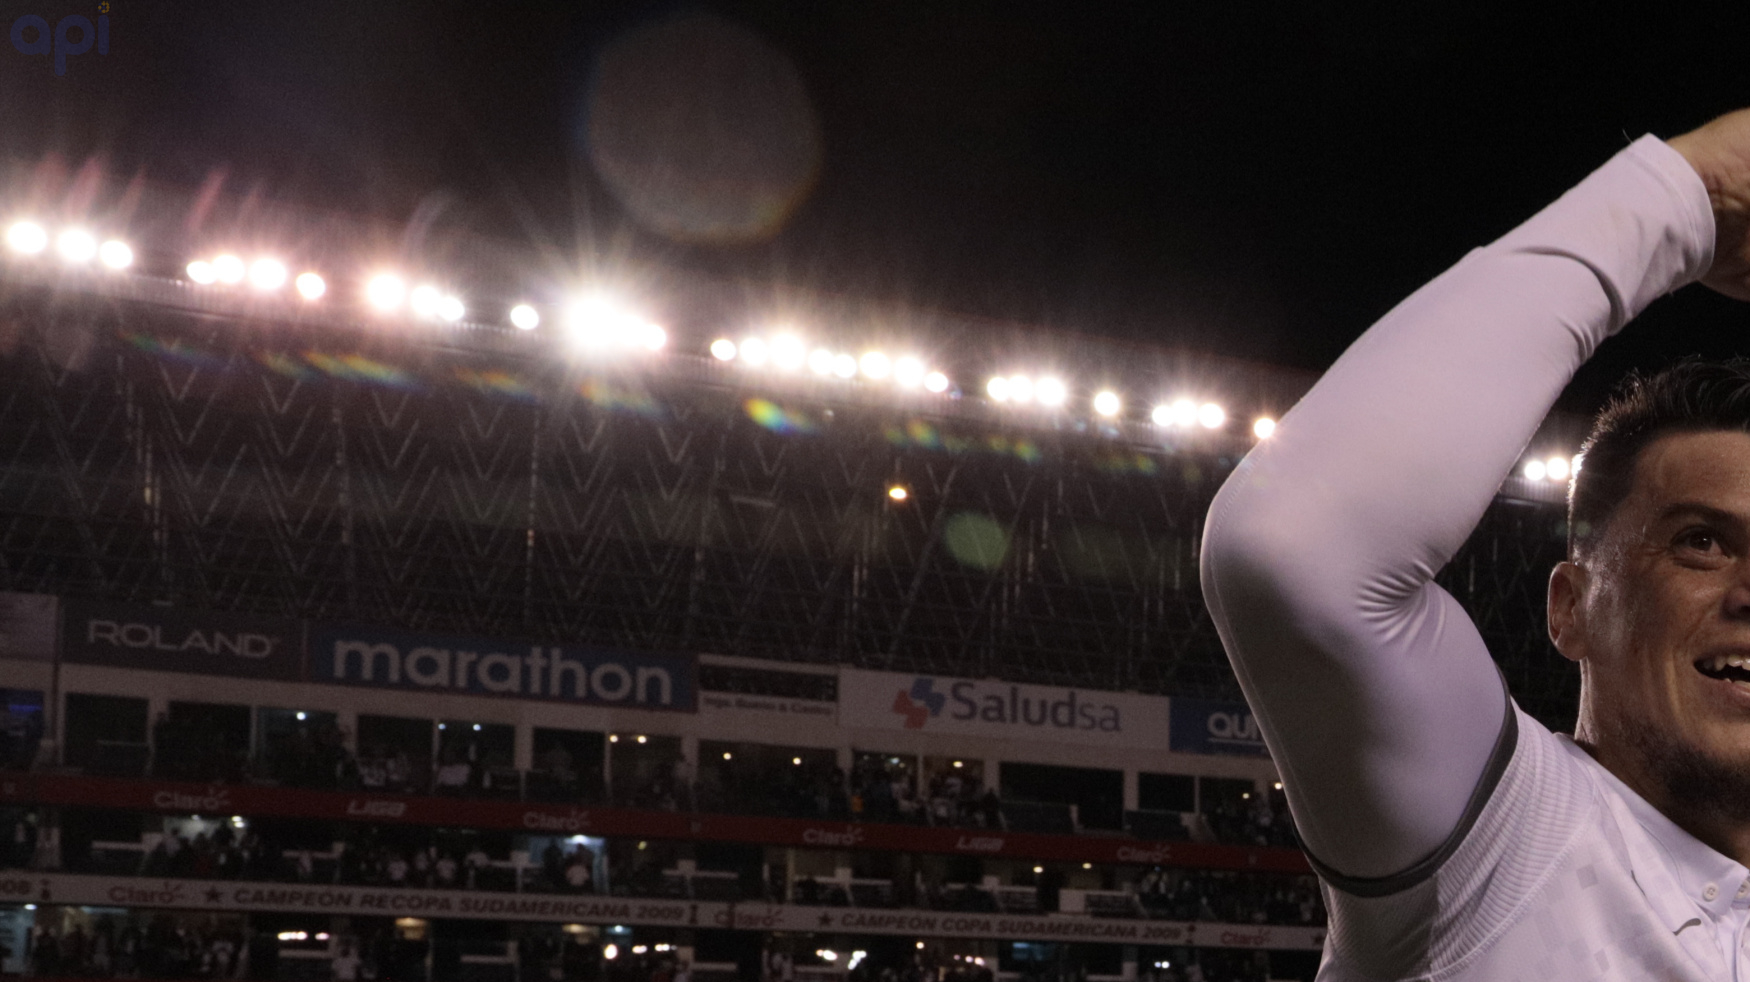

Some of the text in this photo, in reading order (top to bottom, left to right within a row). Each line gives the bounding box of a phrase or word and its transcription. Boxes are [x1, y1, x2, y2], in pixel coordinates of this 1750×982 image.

[88, 619, 274, 659] ROLAND
[333, 638, 671, 705] marathon
[950, 681, 1121, 732] Saludsa
[154, 789, 224, 810] Claro
[523, 810, 583, 831] Claro
[802, 828, 858, 846] Claro
[1116, 846, 1170, 863] Claro
[107, 886, 177, 904] Claro
[358, 893, 451, 911] RECOPA
[459, 897, 631, 919] SUDAMERICANA
[634, 901, 684, 920] 2009
[941, 917, 993, 933] COPA
[997, 921, 1138, 938] SUDAMERICANA
[1142, 927, 1181, 940] 2009
[1219, 930, 1264, 946] Claro
